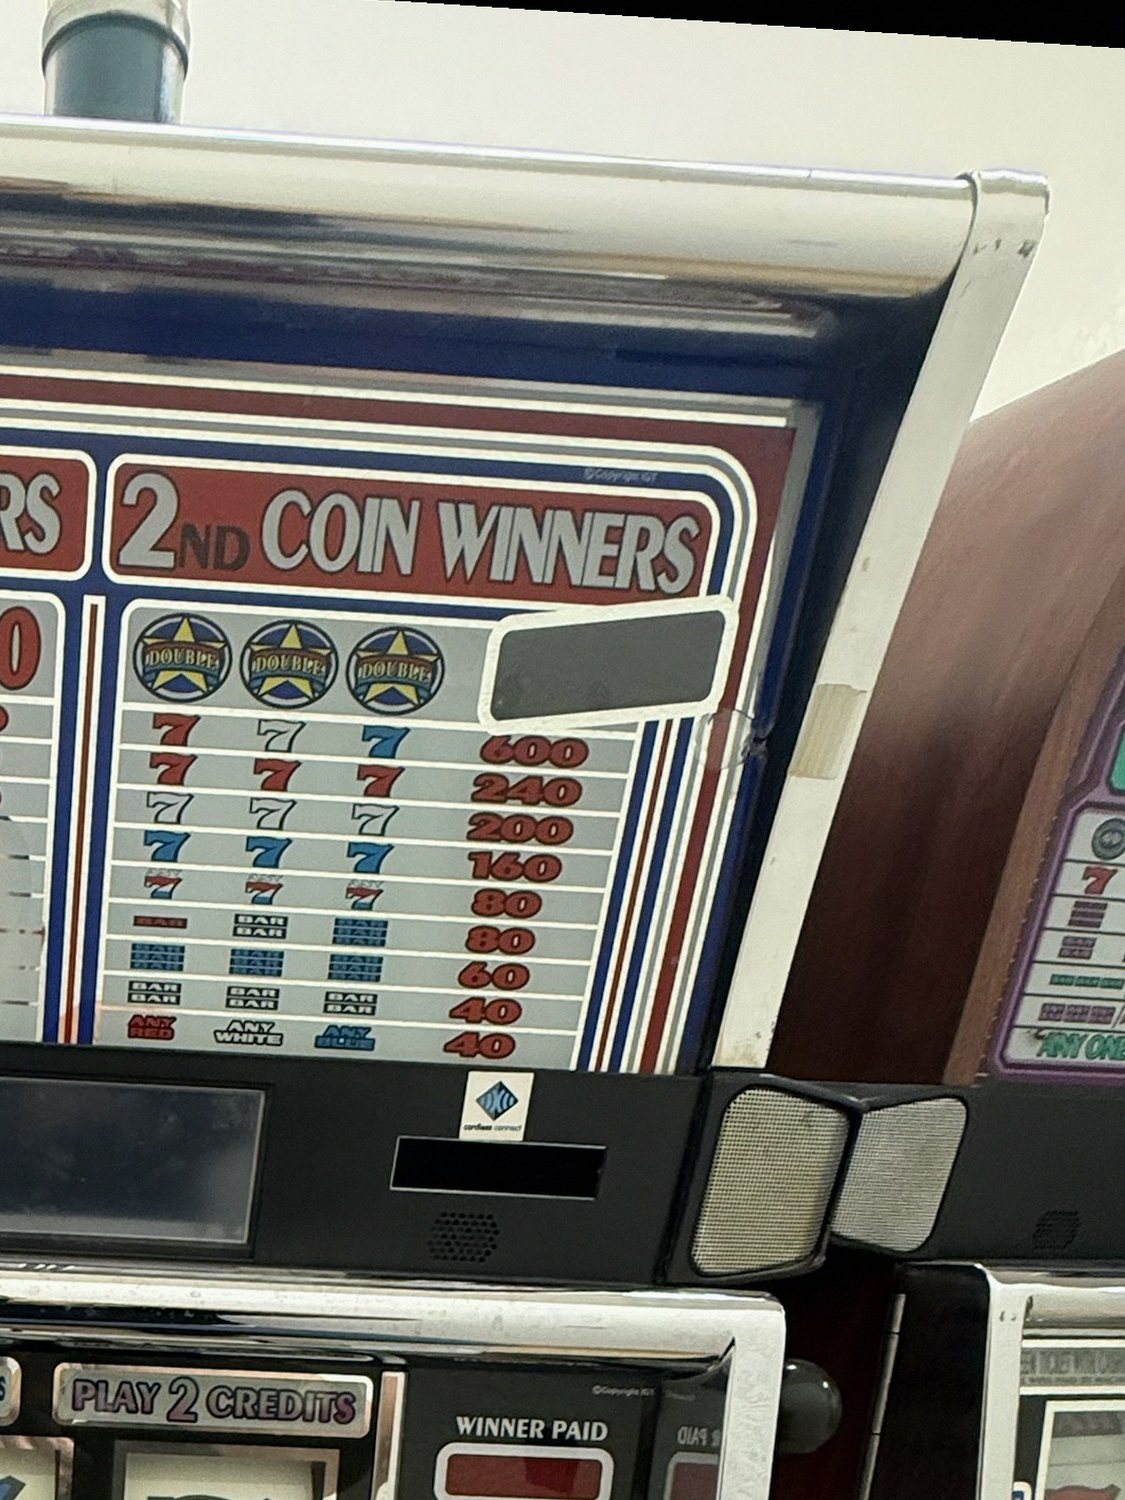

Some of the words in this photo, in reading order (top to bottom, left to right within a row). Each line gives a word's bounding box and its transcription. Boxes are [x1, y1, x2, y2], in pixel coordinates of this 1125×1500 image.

[119, 472, 250, 570] 2ND
[262, 489, 421, 576] COIN
[437, 502, 699, 595] WINNERS
[149, 649, 219, 669] DOUBLE
[256, 655, 324, 676] DOUBLE
[361, 661, 430, 683] DOUBLE
[153, 712, 201, 745] 7
[258, 719, 306, 752] 7
[362, 725, 411, 758] 7
[480, 736, 589, 768] 600
[471, 772, 582, 807] 240
[467, 812, 573, 845] 200
[468, 851, 561, 882] 160
[1082, 867, 1118, 894] 7
[471, 888, 543, 918] 80
[235, 926, 283, 938] BAR
[237, 914, 285, 926] BAR
[465, 925, 535, 955] 80
[458, 961, 530, 990] 60
[449, 996, 522, 1025] 40
[215, 1030, 283, 1046] WHITE
[227, 1020, 275, 1034] ANY
[443, 1031, 515, 1059] 40
[1036, 1031, 1088, 1060] ANY
[464, 1123, 492, 1131] cordless
[72, 1378, 161, 1414] PLAY
[167, 1376, 199, 1423] 2
[206, 1385, 356, 1424] CREDITS
[456, 1416, 545, 1439] WINNER
[551, 1420, 608, 1442] PAID
